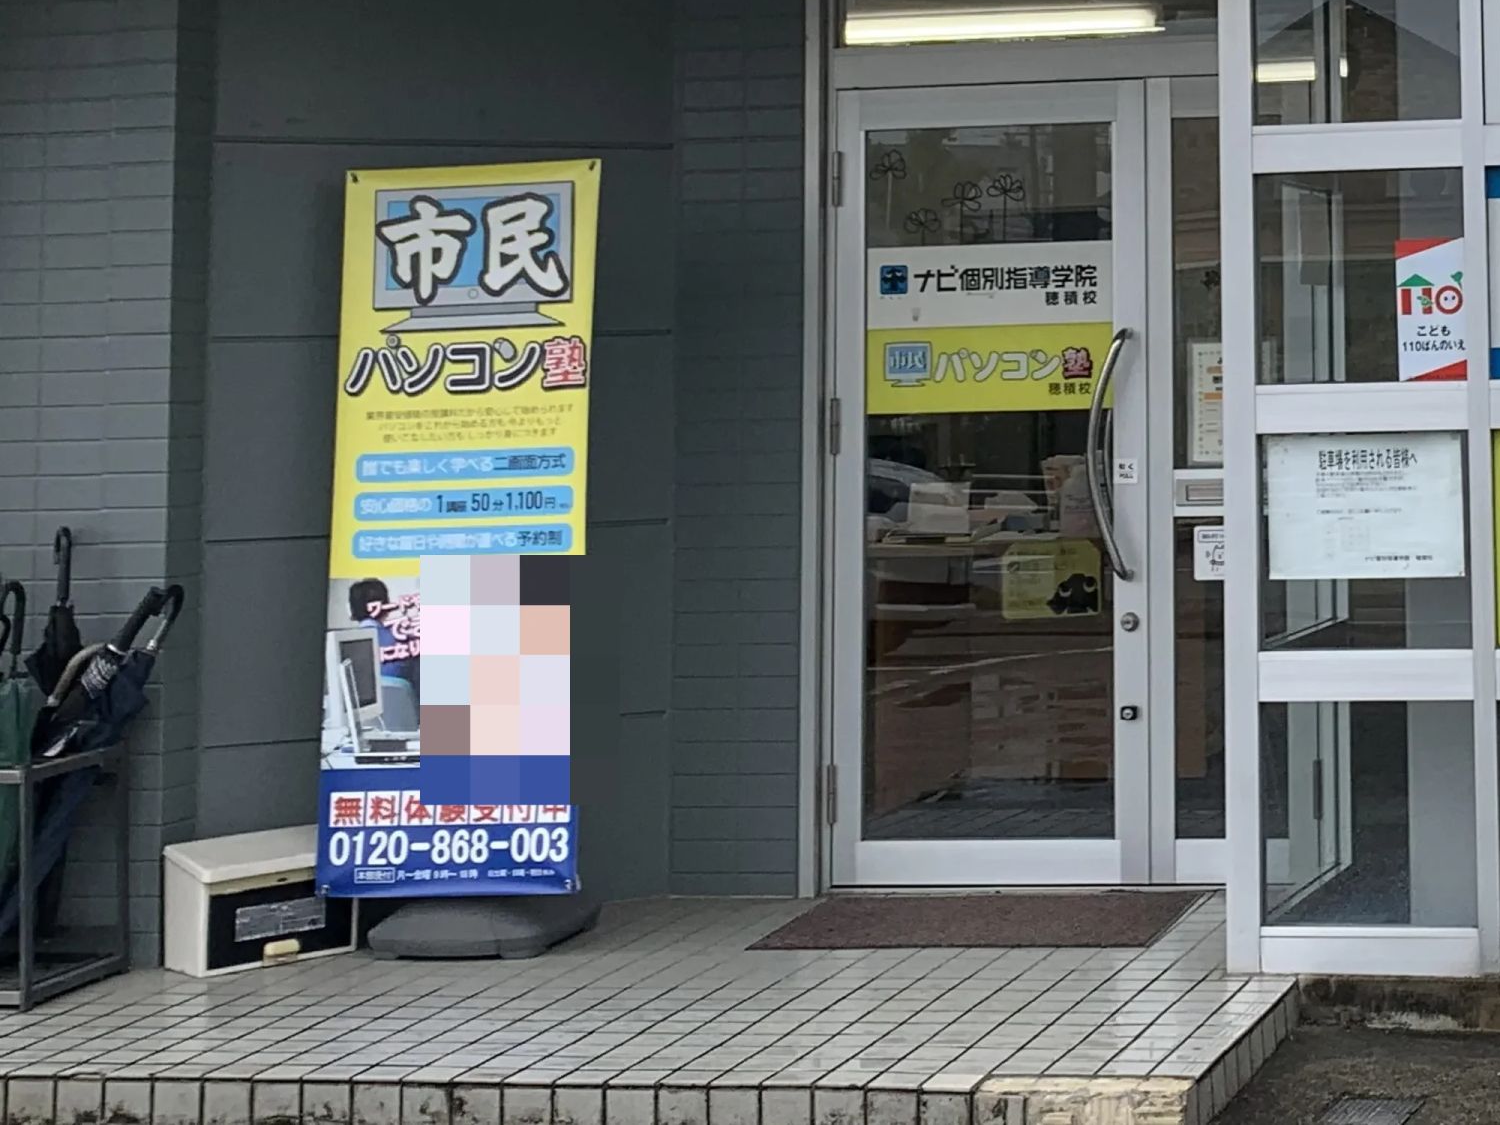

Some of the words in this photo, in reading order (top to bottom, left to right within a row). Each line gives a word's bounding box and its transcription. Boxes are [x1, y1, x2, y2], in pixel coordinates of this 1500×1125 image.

[375, 191, 569, 305] 市民
[913, 265, 1098, 293] ナビ個別指導学院
[1403, 339, 1466, 352] 110ばんのいえ
[1416, 325, 1451, 337] こども
[345, 333, 588, 397] パソコン塾
[933, 347, 1094, 383] パソコン塾
[329, 827, 569, 866] 0120-868-003
